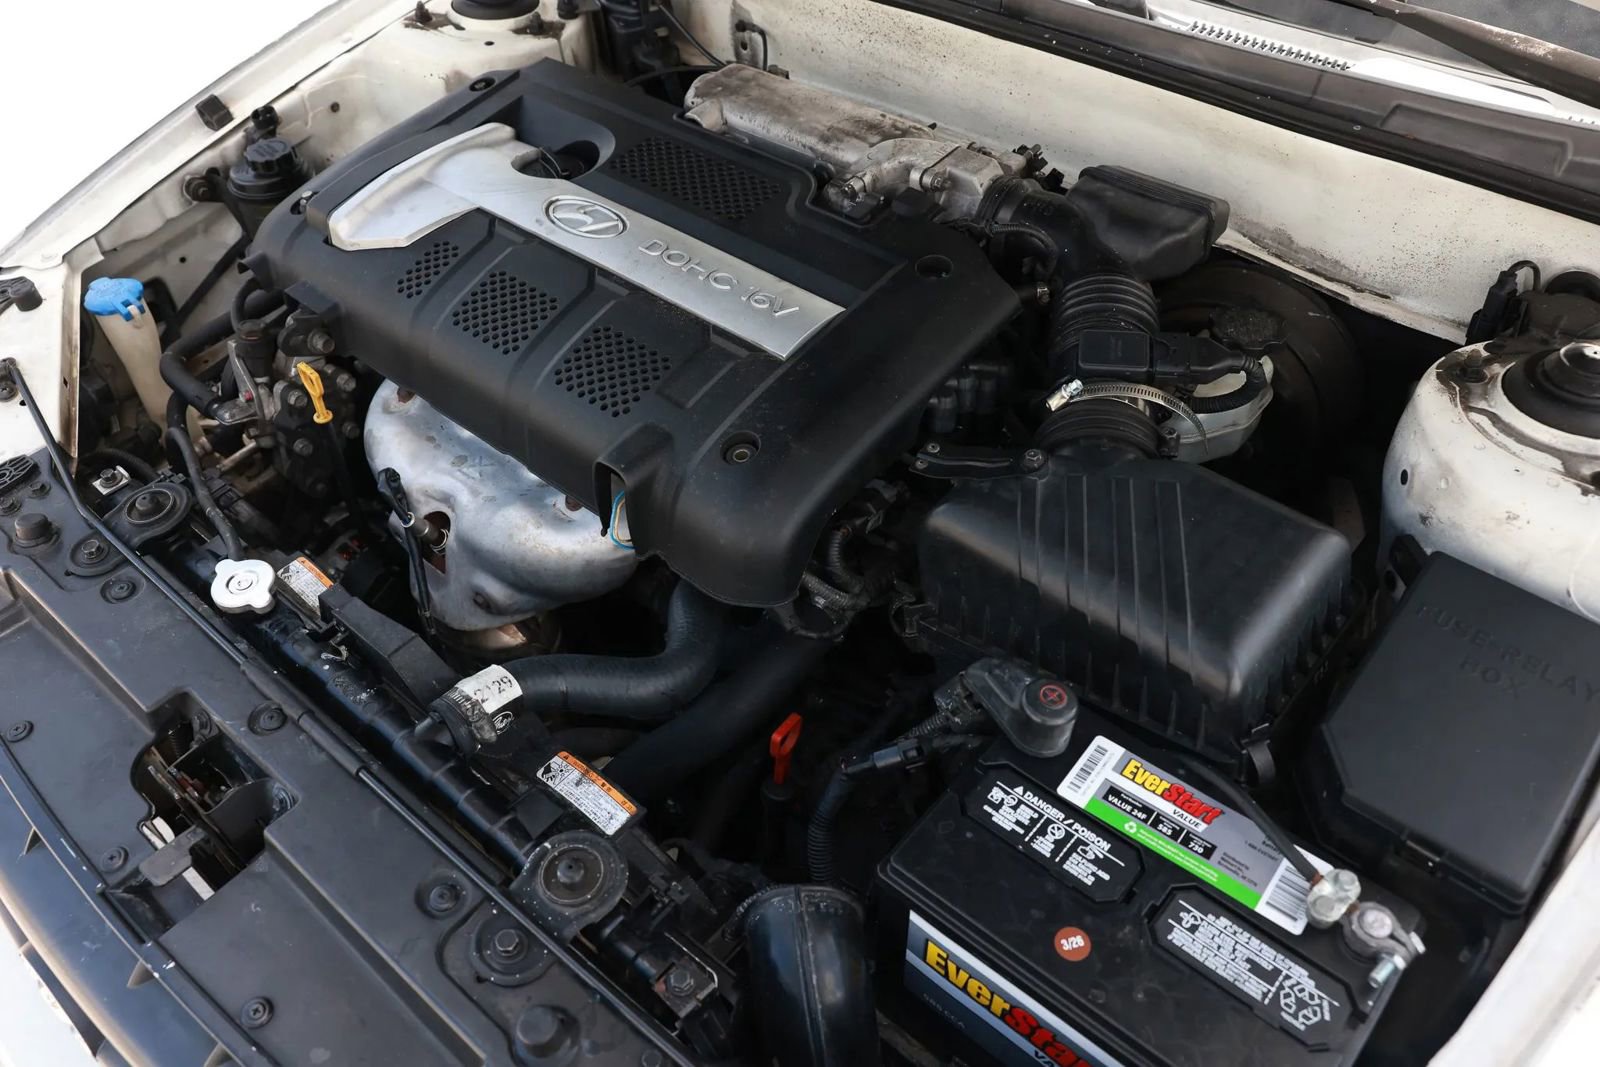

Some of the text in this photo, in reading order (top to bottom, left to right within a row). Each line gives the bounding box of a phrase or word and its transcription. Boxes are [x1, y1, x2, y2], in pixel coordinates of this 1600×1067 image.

[638, 239, 800, 317] DOHC 16V
[1107, 794, 1148, 821] VALUE 24F
[1120, 757, 1223, 826] EverStart
[1023, 790, 1065, 821] DANGER
[1071, 822, 1112, 852] POISON
[1172, 808, 1203, 829] VALUE
[1187, 842, 1205, 854] 730
